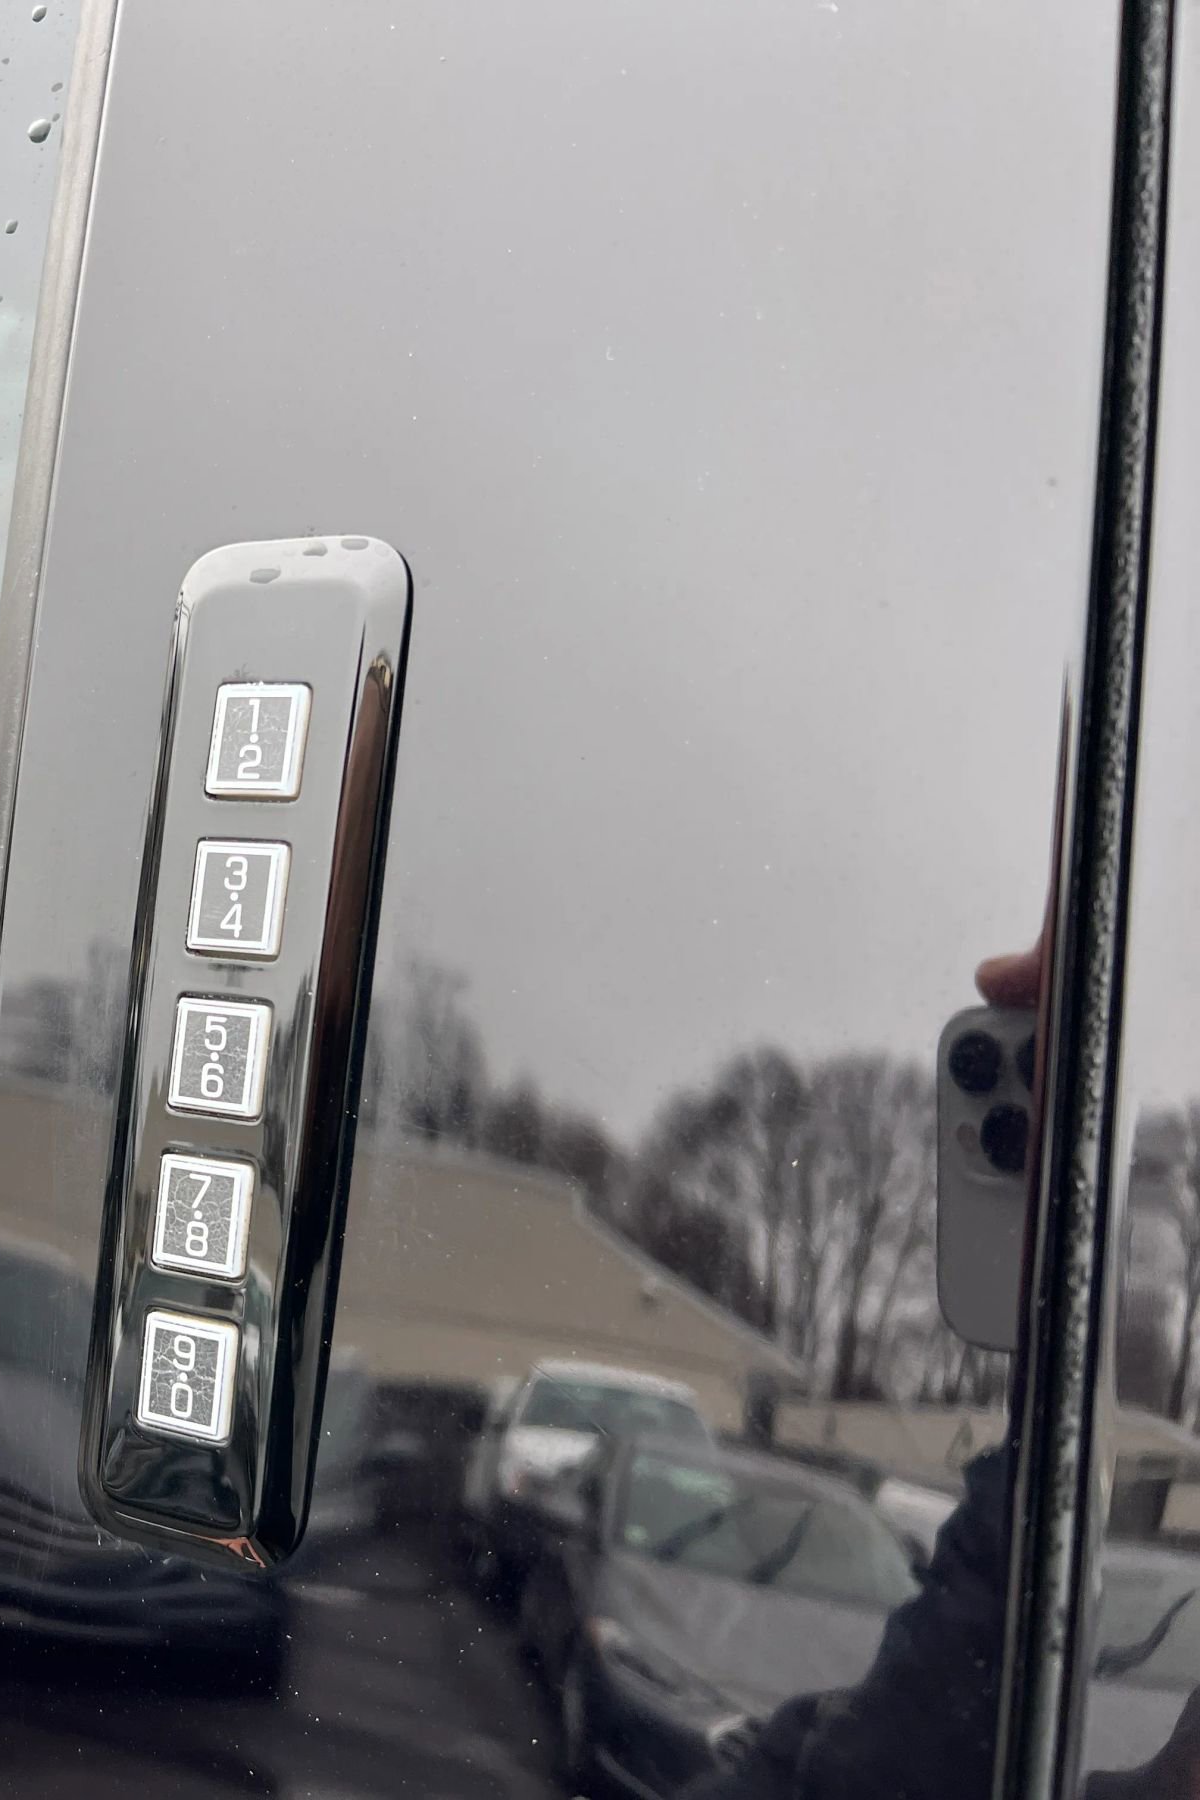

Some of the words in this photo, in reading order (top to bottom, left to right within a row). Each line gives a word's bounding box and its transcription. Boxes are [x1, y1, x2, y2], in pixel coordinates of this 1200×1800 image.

[249, 698, 261, 733] 1
[237, 744, 262, 780] 2
[224, 856, 248, 891] 3
[220, 903, 243, 938] 4
[204, 1015, 228, 1051] 5
[200, 1062, 224, 1098] 6
[189, 1173, 212, 1209] 7
[185, 1220, 209, 1258] 8
[173, 1334, 196, 1372] 9
[170, 1382, 193, 1418] 0
